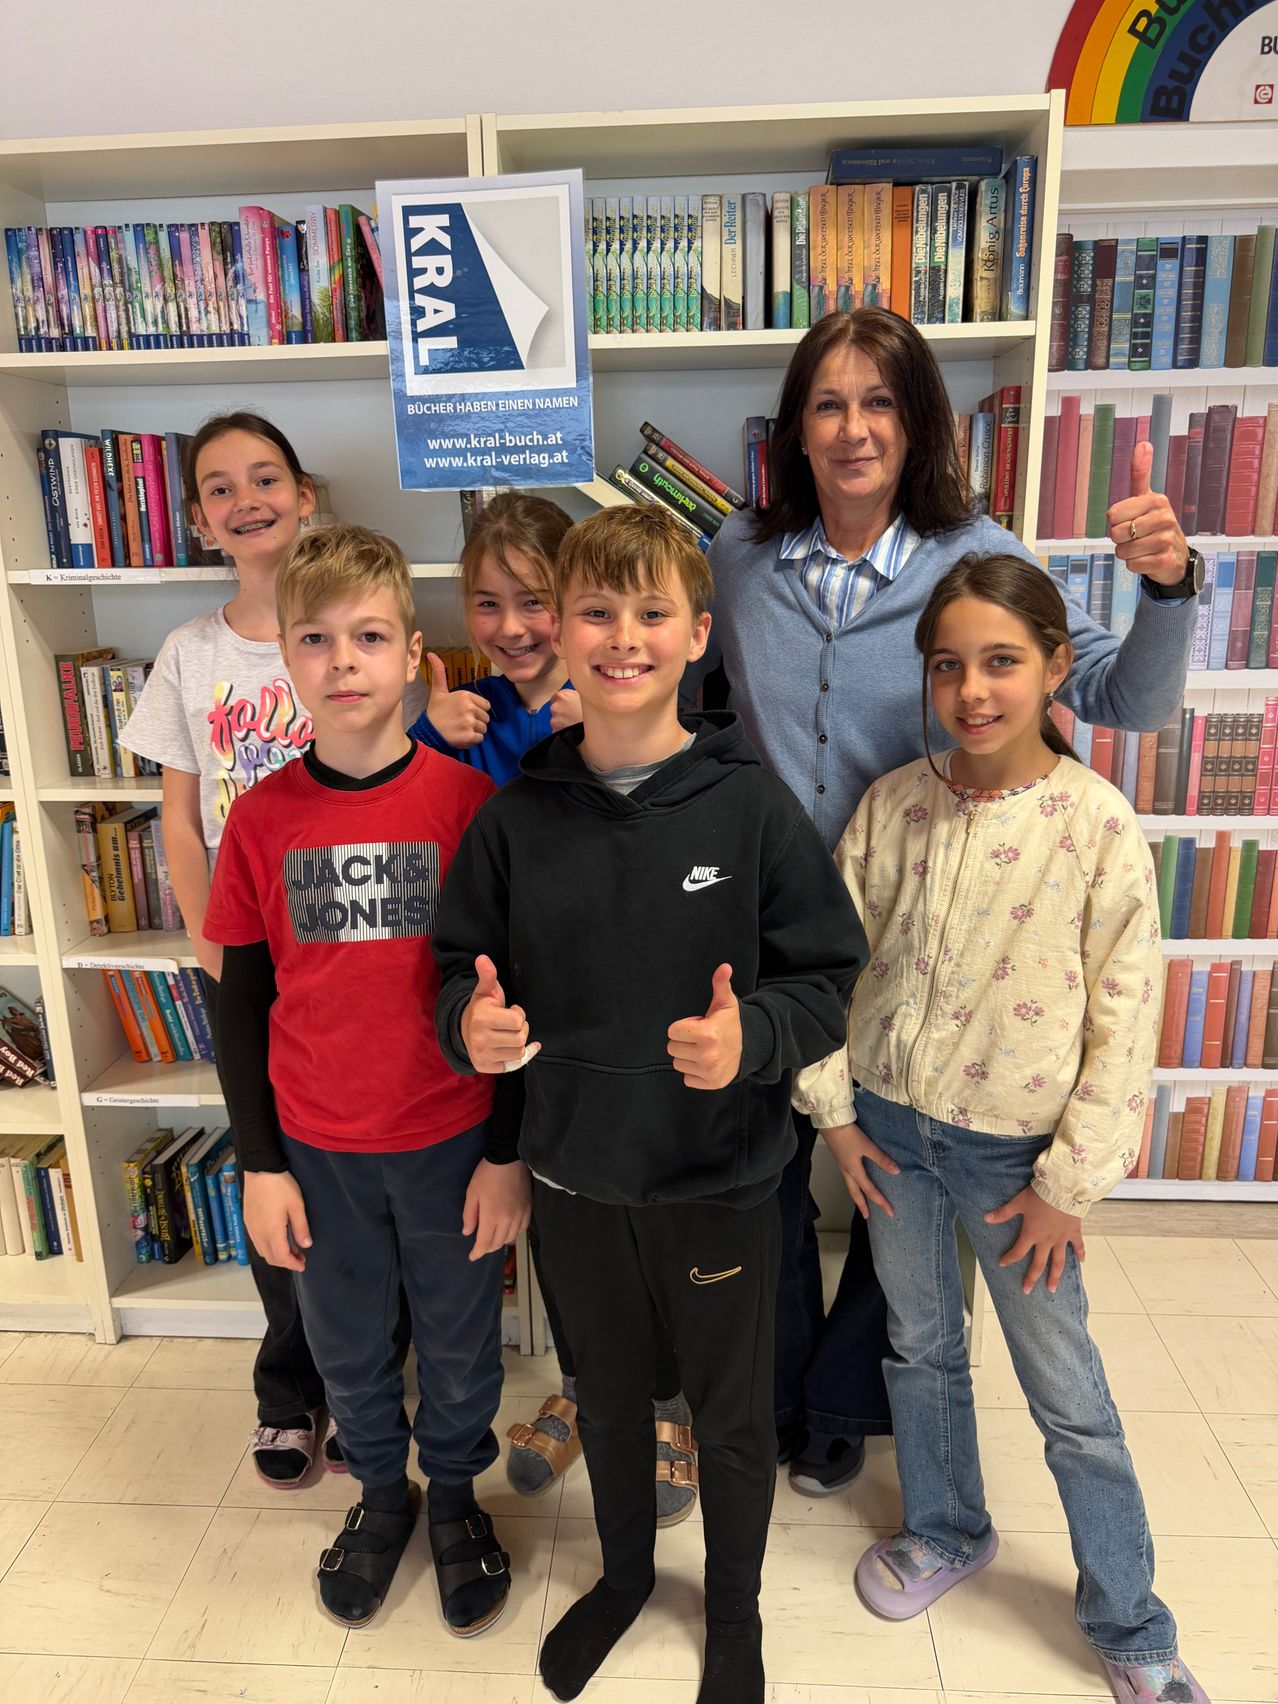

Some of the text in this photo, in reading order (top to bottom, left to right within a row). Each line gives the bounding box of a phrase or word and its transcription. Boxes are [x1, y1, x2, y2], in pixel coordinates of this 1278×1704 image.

[1151, 0, 1257, 119] Buch
[724, 200, 736, 245] Der Reiter
[914, 194, 928, 248] Nibelungen
[935, 192, 948, 247] Nibelungen
[986, 187, 999, 227] Artus
[310, 211, 320, 256] SOMMERBY
[795, 233, 807, 245] Die
[1016, 167, 1030, 295] Braumann Sagenreise durch Europa
[914, 248, 927, 262] Die
[934, 247, 947, 262] Die
[983, 231, 999, 272] König
[408, 213, 459, 366] KRAL
[407, 396, 578, 415] BÜCHER HABEN EINEN NAMEN
[104, 438, 115, 477] WILDHEXE
[424, 449, 568, 469] www.kral-verlag.at
[427, 431, 563, 450] www.kral-buch.at
[48, 458, 60, 507] OSTWIND
[979, 451, 991, 490] Robinson
[60, 573, 121, 582] Kriminalgeschichte
[59, 661, 84, 751] FEUERFALKE
[107, 873, 118, 901] BLYTON
[112, 853, 126, 901] Geheimnis
[690, 866, 720, 880] NIKE
[300, 895, 430, 933] JONES
[0, 1046, 35, 1078] Red Boy
[5, 1070, 25, 1087] Red
[109, 1096, 159, 1104] Geistergeschichte
